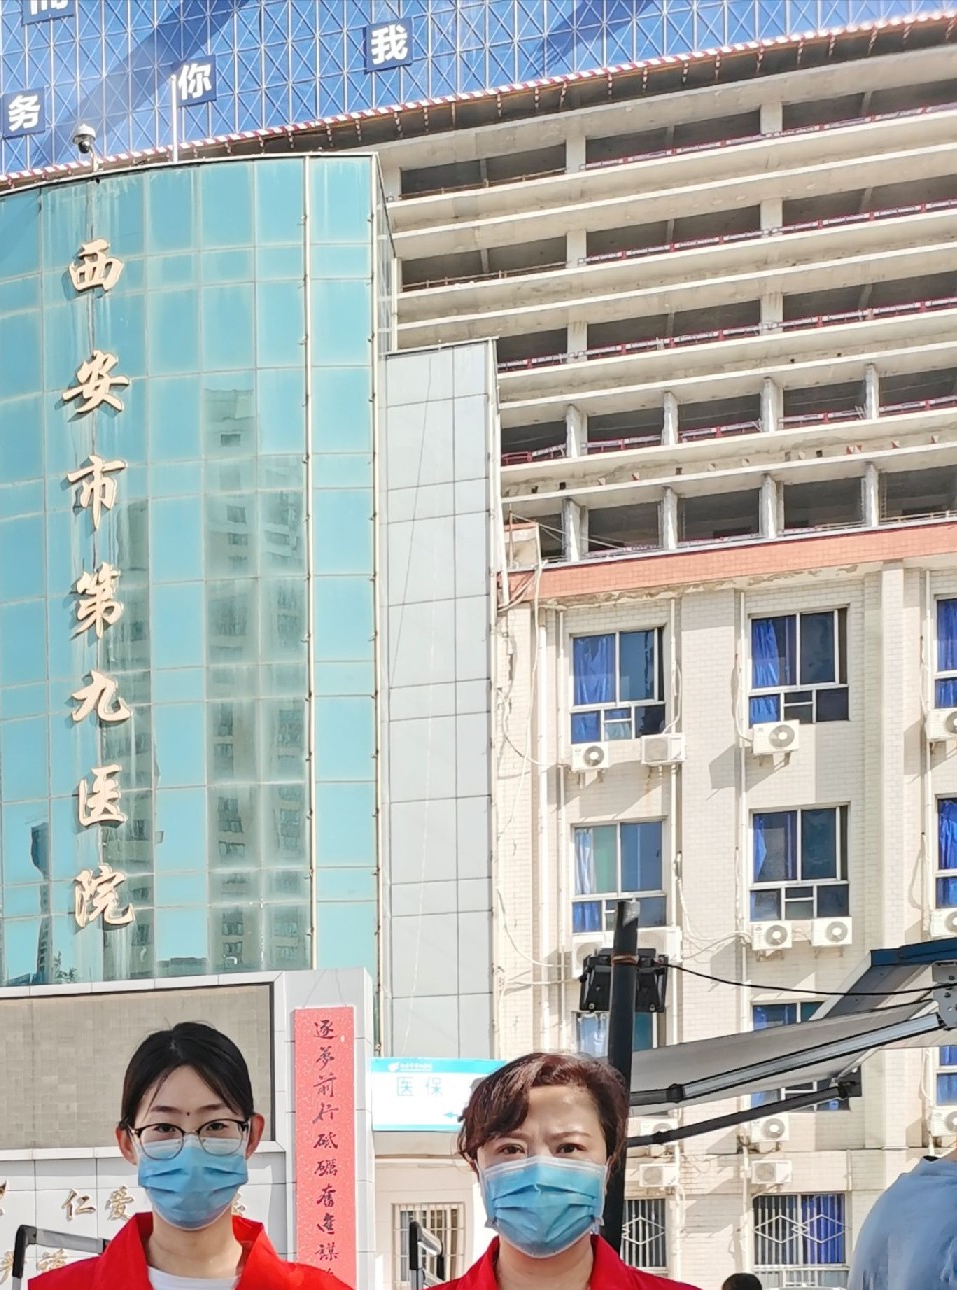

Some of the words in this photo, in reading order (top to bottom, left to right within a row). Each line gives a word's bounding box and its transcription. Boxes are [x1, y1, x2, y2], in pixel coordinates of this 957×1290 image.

[63, 238, 136, 928] 西安市第九医院
[397, 1077, 443, 1096] 医保
